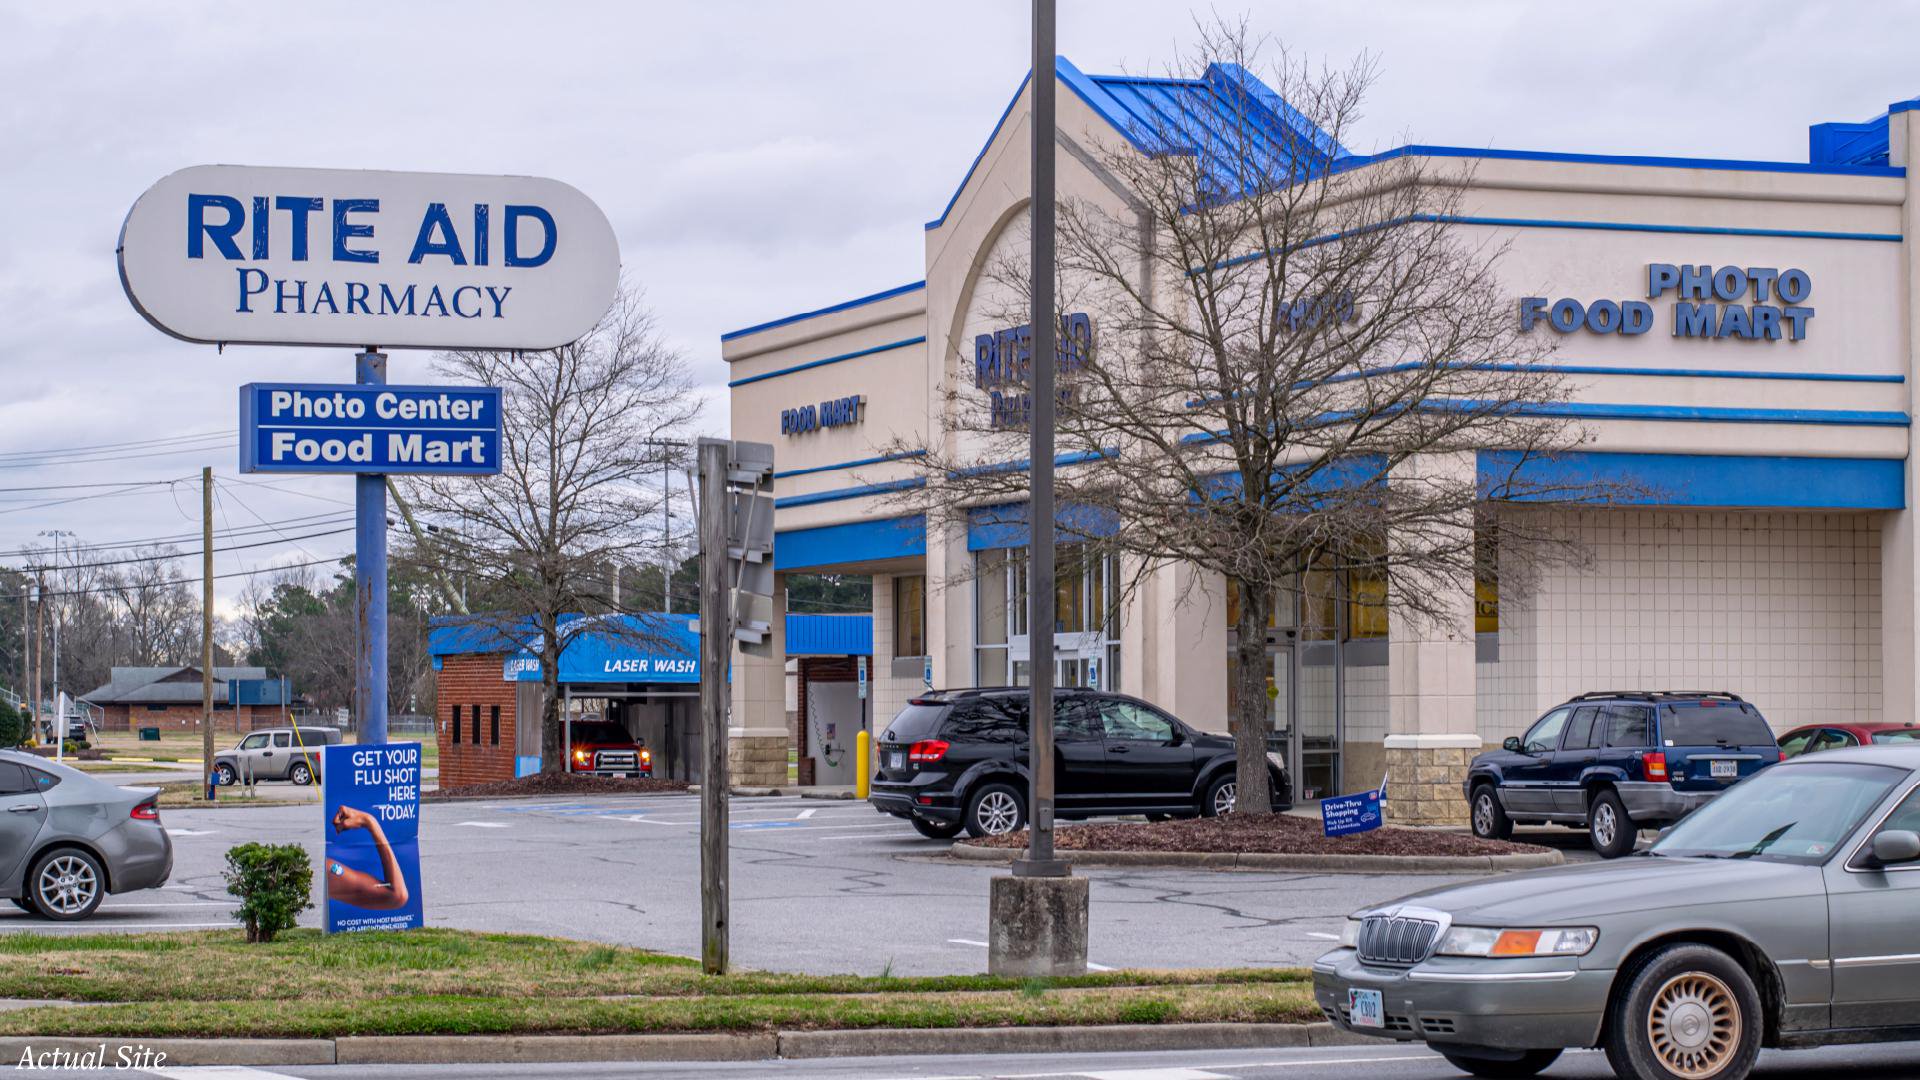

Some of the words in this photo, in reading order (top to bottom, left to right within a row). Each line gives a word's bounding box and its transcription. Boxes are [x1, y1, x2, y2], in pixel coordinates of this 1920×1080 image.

[187, 193, 380, 264] RITE
[407, 202, 558, 269] AID
[235, 267, 513, 319] PHARMACY
[1647, 263, 1812, 304] PHOTO
[1519, 297, 1654, 336] FOOD
[1673, 302, 1815, 341] MART
[271, 391, 365, 419] Photo
[375, 392, 484, 420] Center
[781, 405, 817, 435] FOOD
[820, 394, 863, 428] MART
[271, 432, 373, 463] Food
[388, 433, 485, 464] Mart
[604, 659, 648, 673] LASER
[654, 660, 696, 673] WASH
[352, 750, 383, 767] GET
[385, 748, 417, 765] YOUR
[354, 769, 382, 786] FLU
[389, 785, 417, 802] HERE
[378, 803, 416, 821] TODAY.
[1324, 800, 1362, 811] Drive-Thru
[1325, 808, 1359, 818] Shopping
[376, 916, 391, 924] MOST
